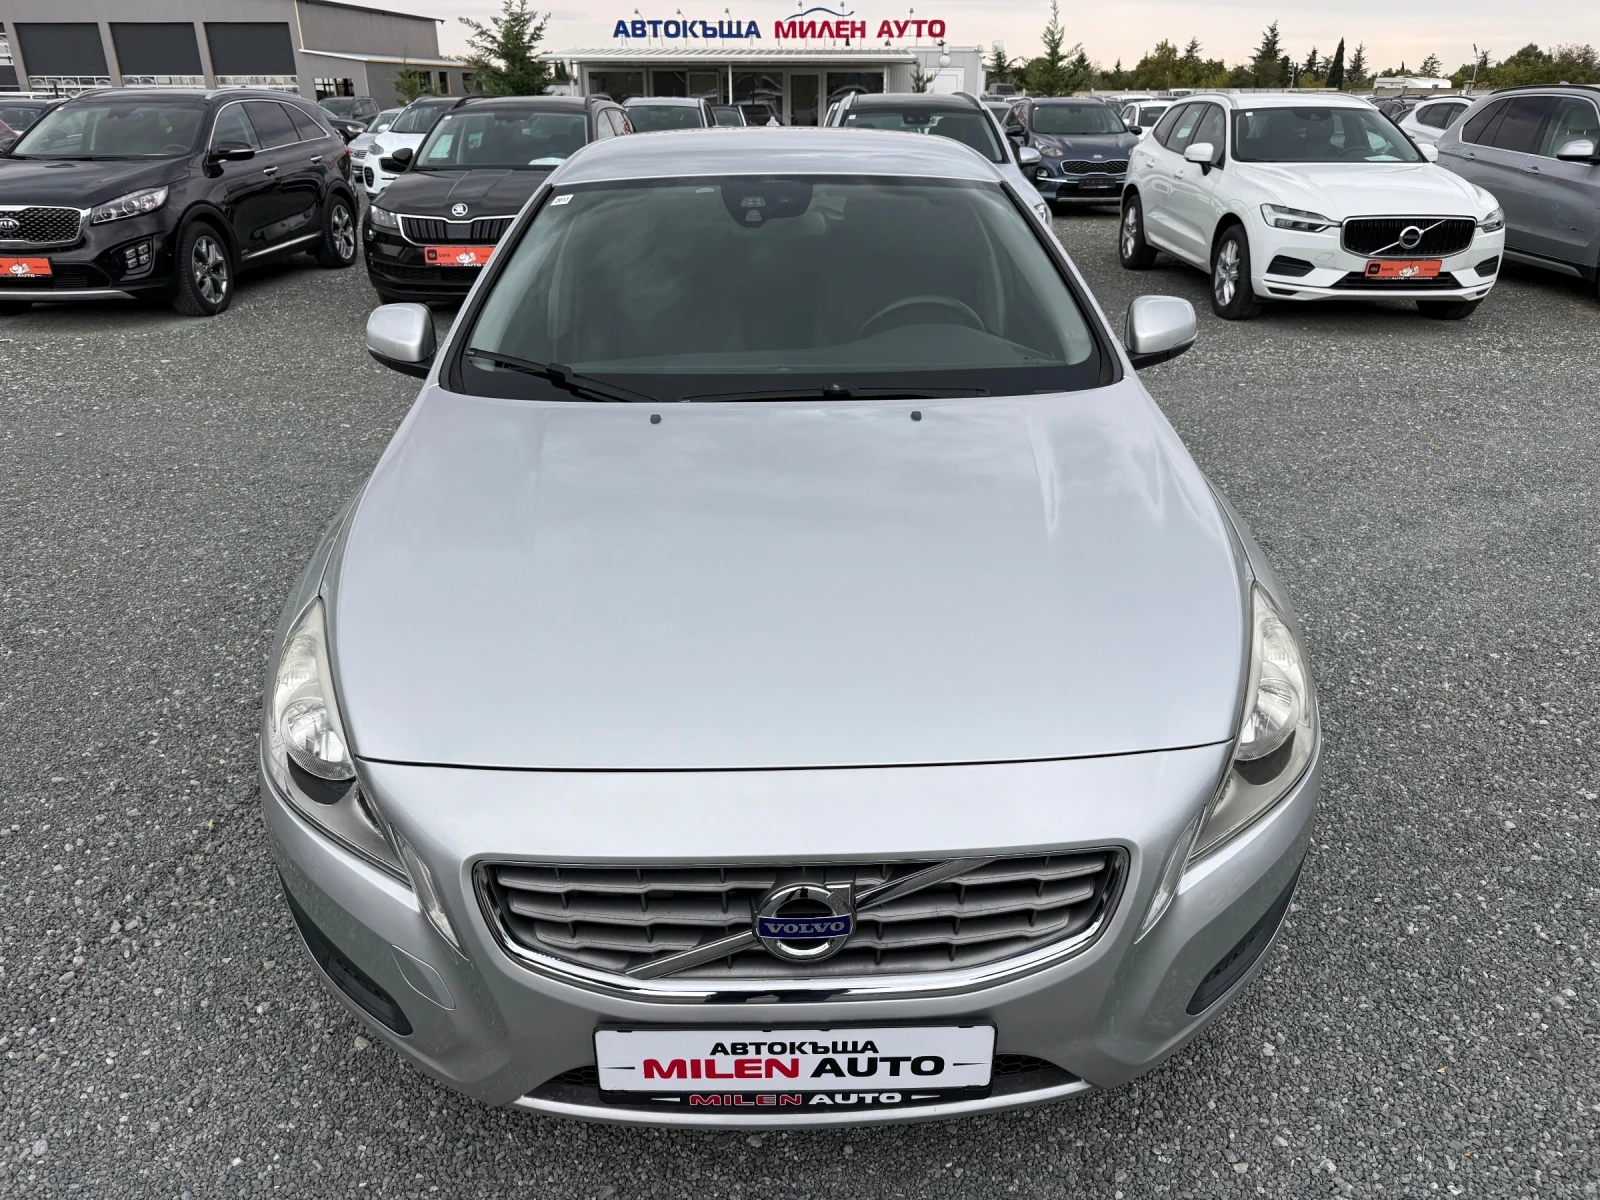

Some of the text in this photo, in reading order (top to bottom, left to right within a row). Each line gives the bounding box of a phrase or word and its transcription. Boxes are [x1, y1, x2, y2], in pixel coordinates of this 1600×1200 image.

[613, 19, 946, 39] АВТОКЪЩА МИЛЕН АУТО
[763, 921, 846, 934] VOLVO
[709, 1039, 880, 1056] АВТОКЪЩА
[642, 1055, 945, 1080] MILEN AUTO
[688, 1092, 903, 1107] MILEN AUTO
